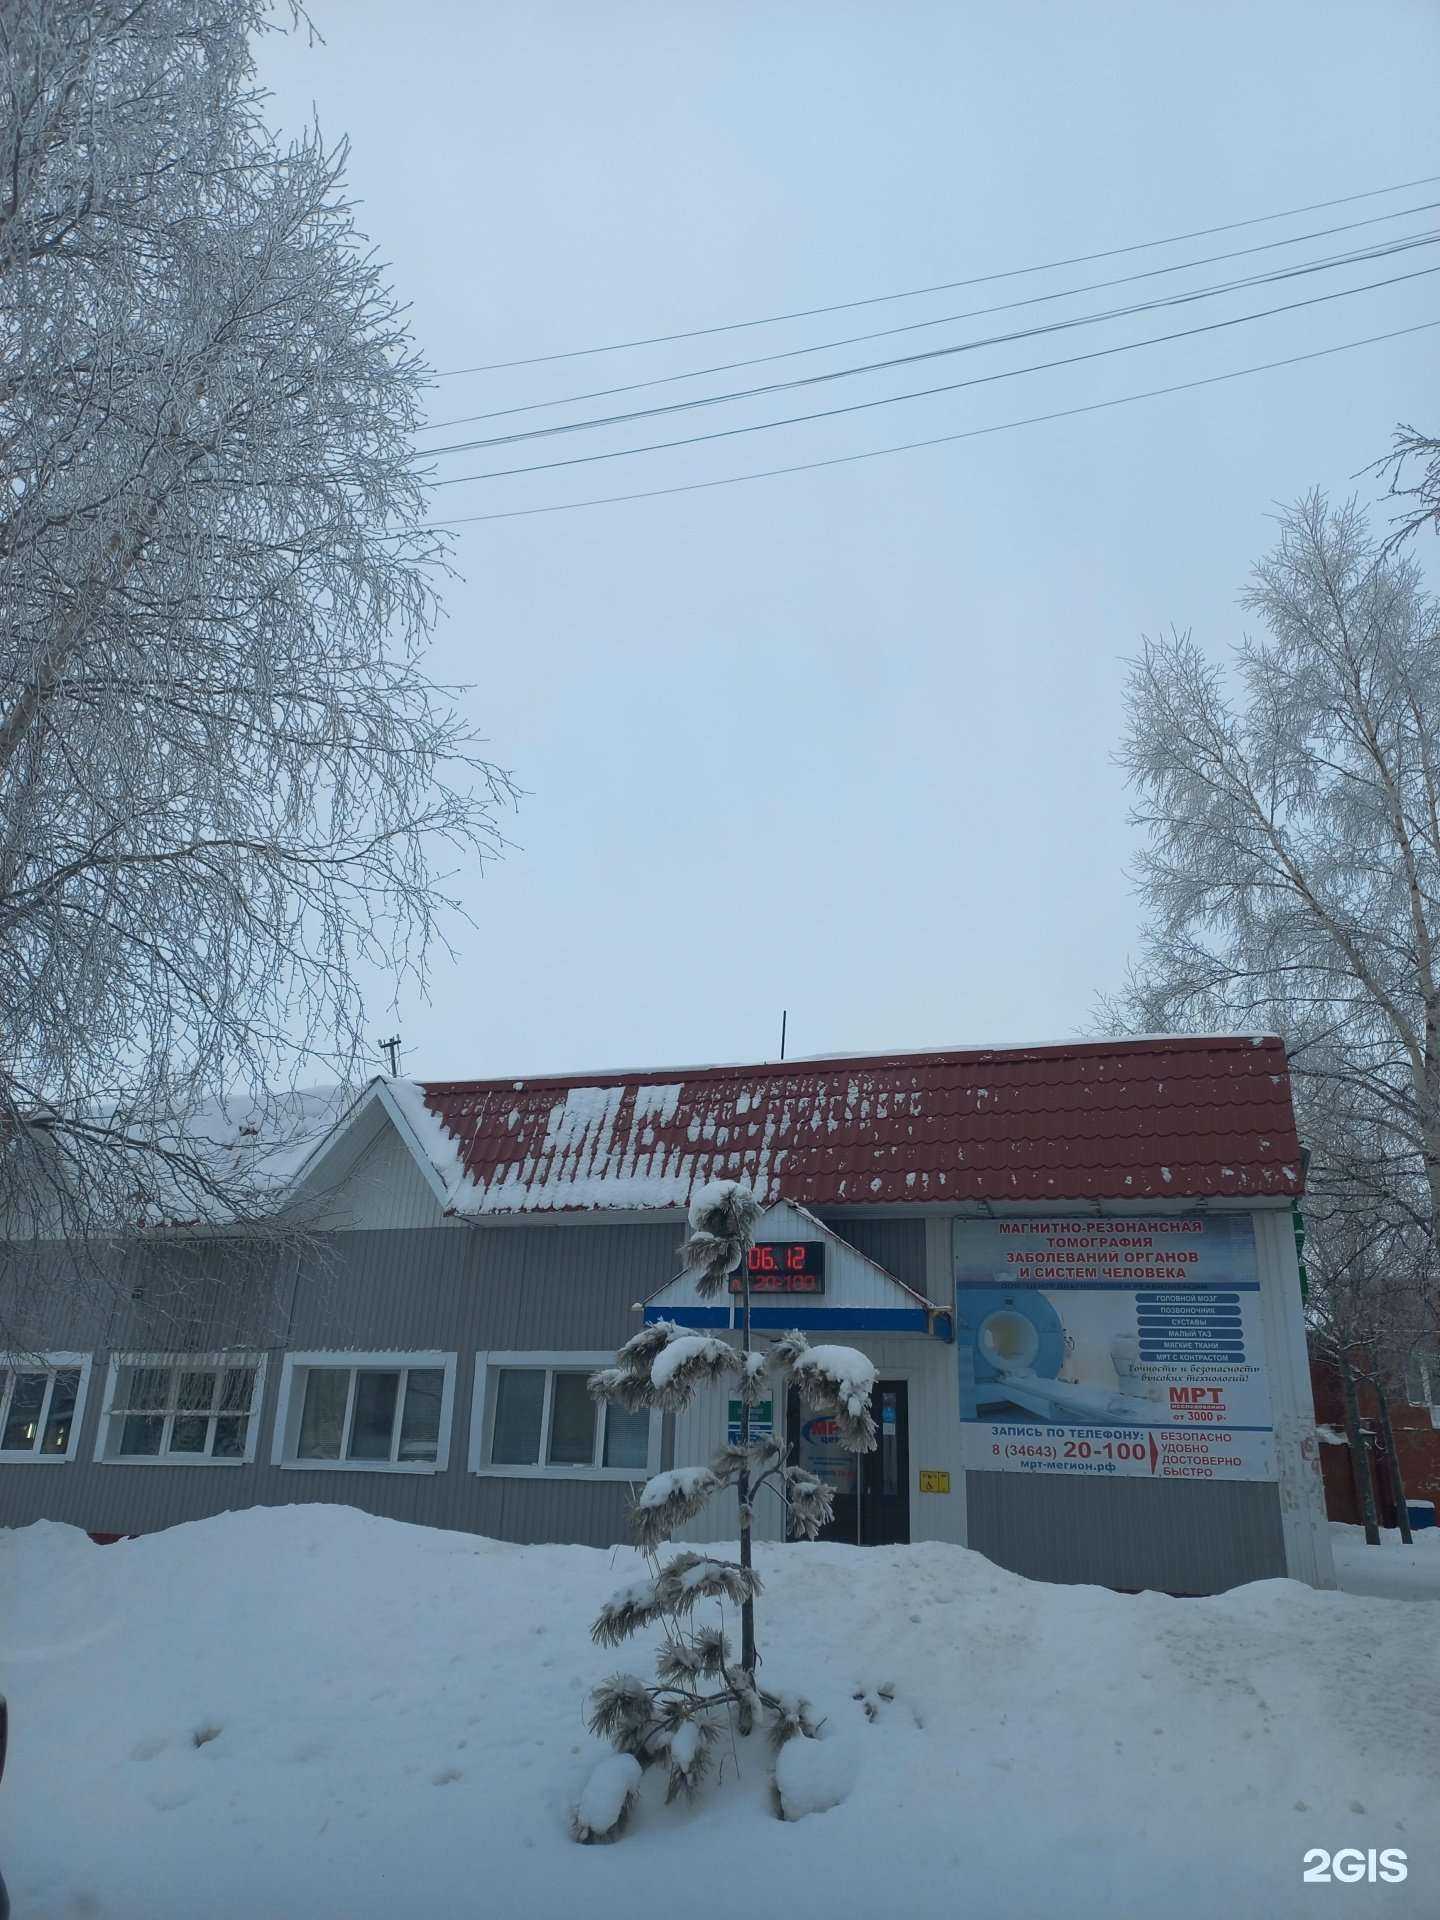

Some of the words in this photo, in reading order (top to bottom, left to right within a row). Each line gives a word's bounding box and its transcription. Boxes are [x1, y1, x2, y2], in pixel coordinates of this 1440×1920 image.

[1000, 1221, 1201, 1234] МАГНИТНО-РЕЗОНАНСНАЯ
[1047, 1237, 1153, 1248] ТОМОГРАФИЯ
[1007, 1251, 1119, 1263] ЗАБОЛЕВАНИЙ
[1124, 1252, 1200, 1263] ОРГАНОВ
[1020, 1267, 1030, 1278] И
[1035, 1267, 1097, 1278] СИСТЕМ
[1103, 1267, 1186, 1279] ЧЕЛОВЕКА
[1156, 1294, 1196, 1303] ГОЛОВНОЙ
[1168, 1329, 1197, 1337] МАЛЫЙ
[1199, 1330, 1212, 1338] ТАЗ
[1156, 1353, 1171, 1361] МРТ
[1179, 1354, 1229, 1362] КОНТРАСТОМ
[1169, 1387, 1223, 1403] МРТ
[1187, 1411, 1213, 1421] 3000
[992, 1427, 1042, 1437] ЗАПИСЬ
[1047, 1428, 1065, 1438] ПО
[1070, 1429, 1144, 1440] ТЕЛЕФОНУ:
[1161, 1432, 1232, 1442] БЕЗОПАСНО
[992, 1443, 1000, 1456] 8
[1005, 1444, 1057, 1460] (34643)
[1063, 1441, 1146, 1460] 20-100
[1161, 1443, 1209, 1453] УДОБНО
[1162, 1455, 1242, 1466] ДОСТОВЕРНО
[1020, 1461, 1117, 1473] мрт-мегион.рф
[1163, 1467, 1213, 1477] БЫСТРО
